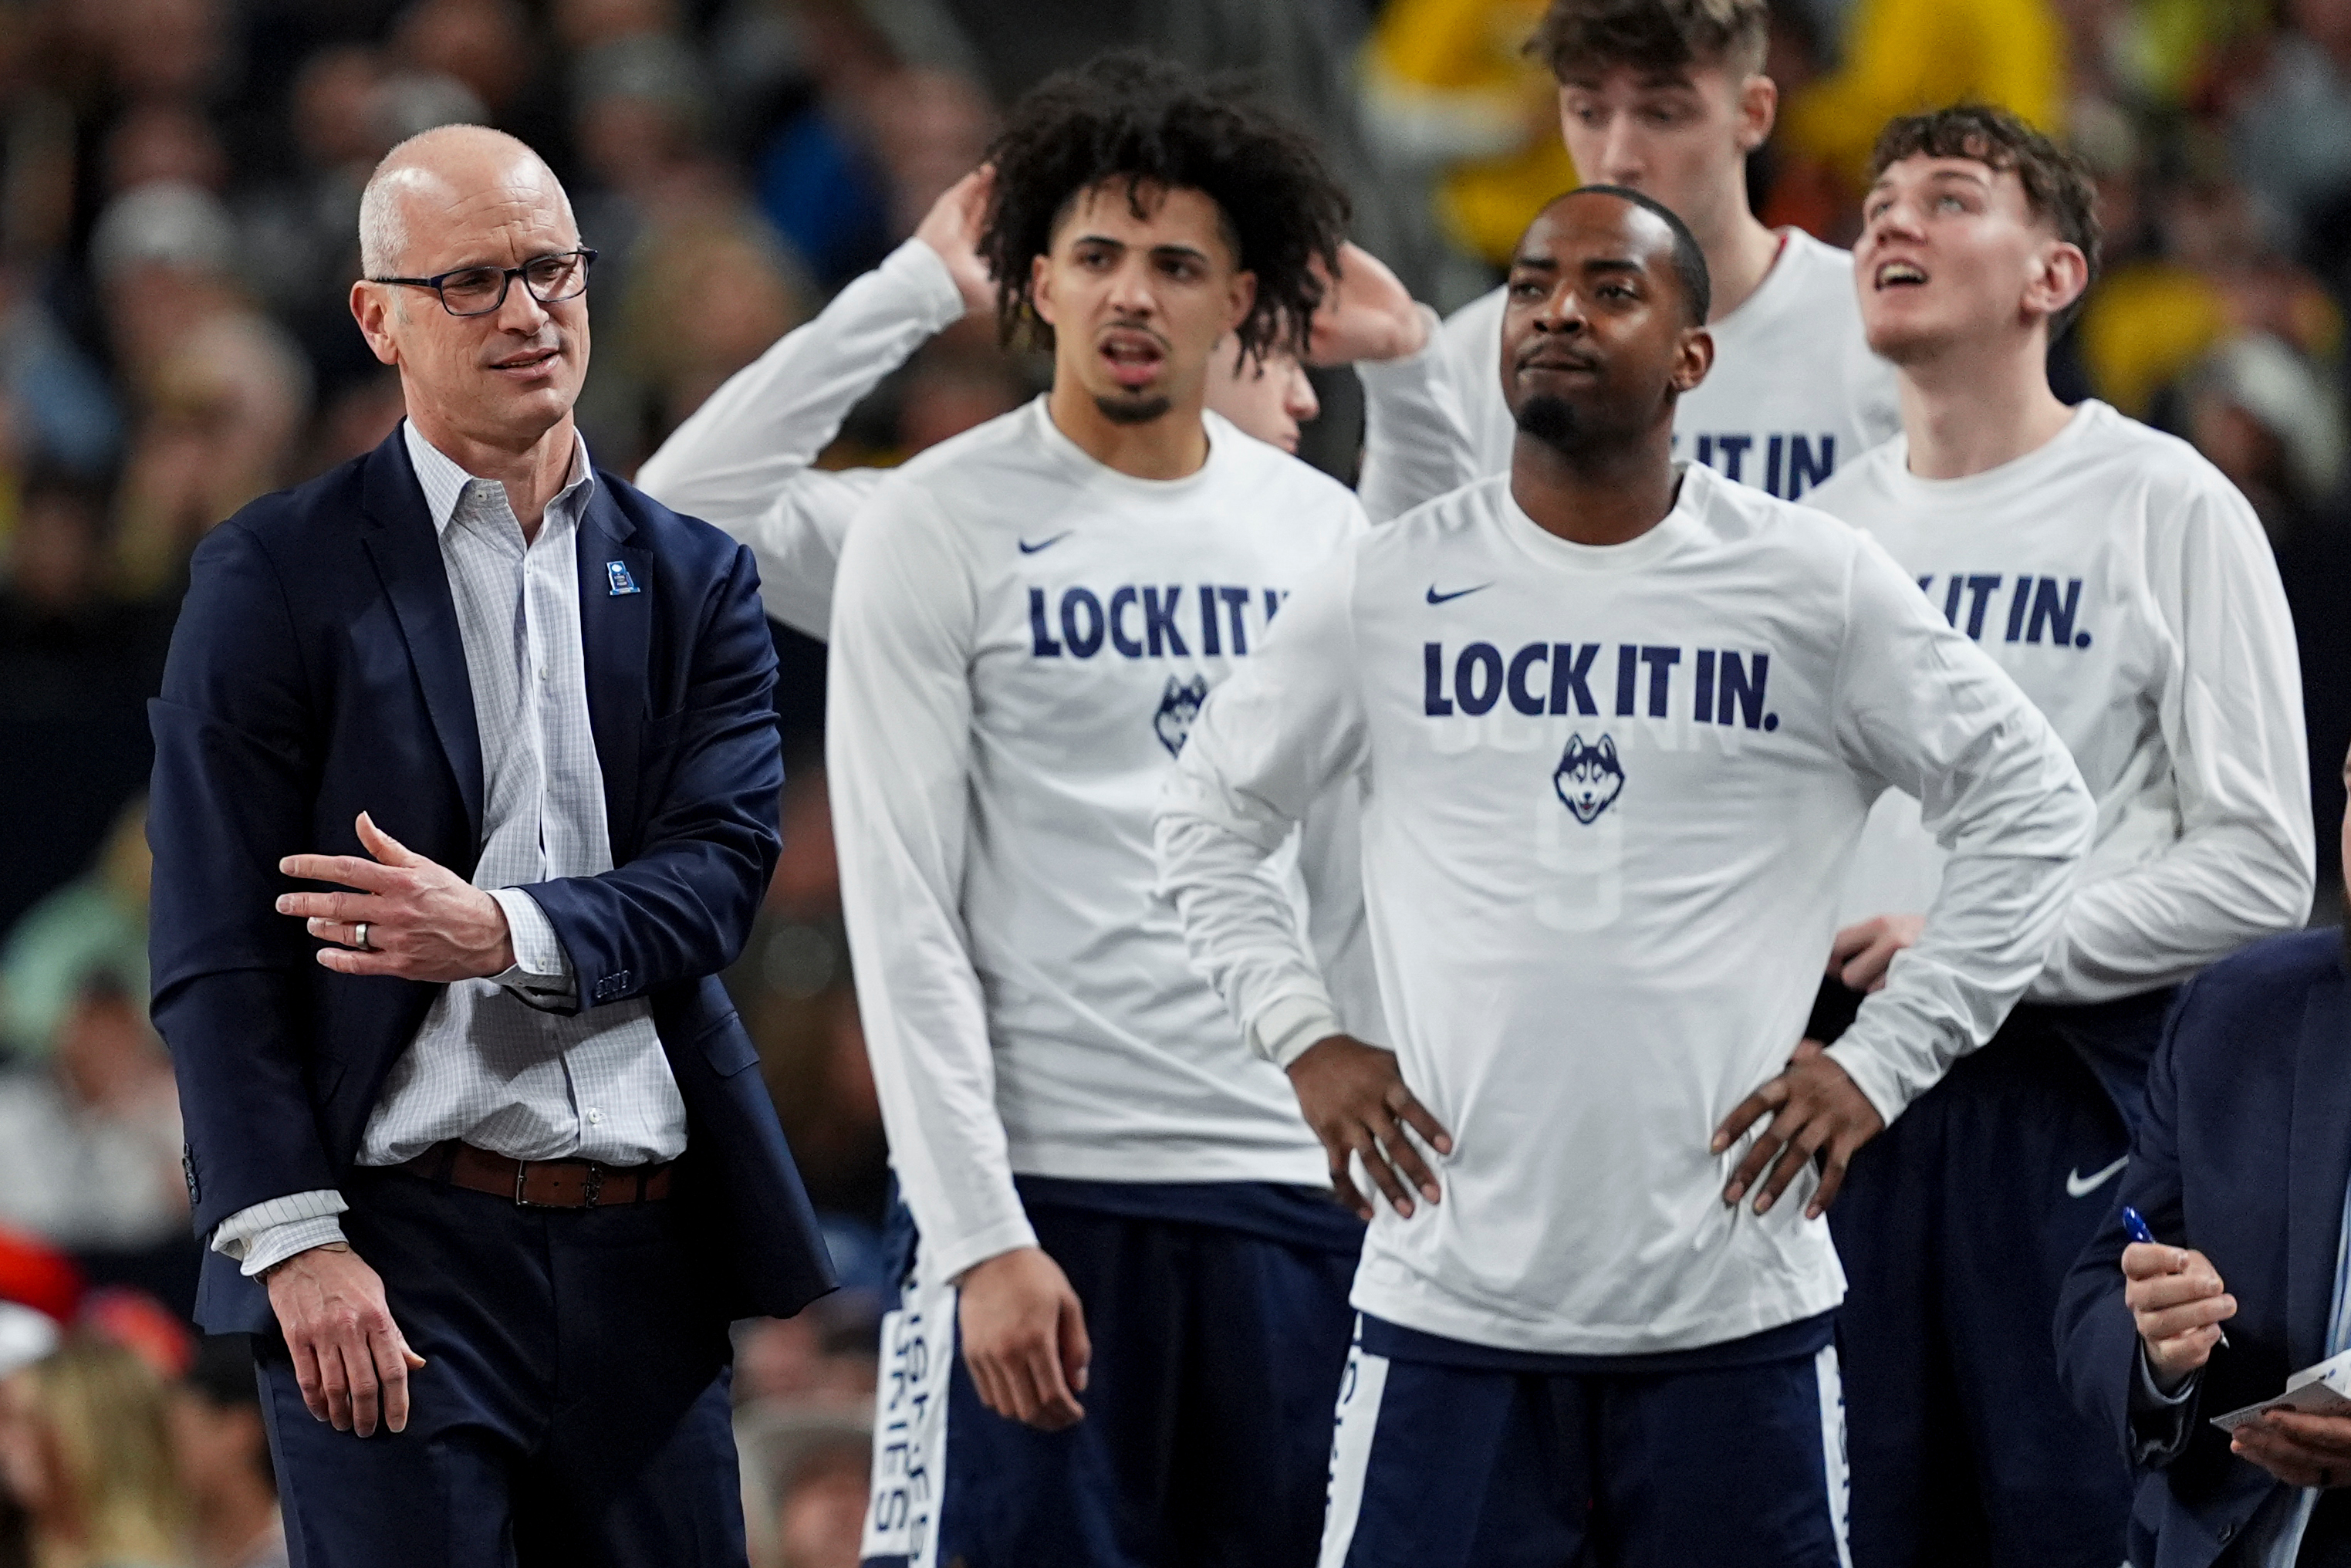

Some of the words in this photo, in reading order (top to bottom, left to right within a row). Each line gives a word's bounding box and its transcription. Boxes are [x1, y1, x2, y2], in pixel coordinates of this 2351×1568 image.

[1029, 586, 1191, 660] LOCK
[1199, 586, 1250, 657] IT
[2005, 576, 2093, 651] IN.
[1424, 642, 1600, 717] LOCK
[1615, 644, 1681, 719] IT
[1694, 648, 1780, 734] IN.
